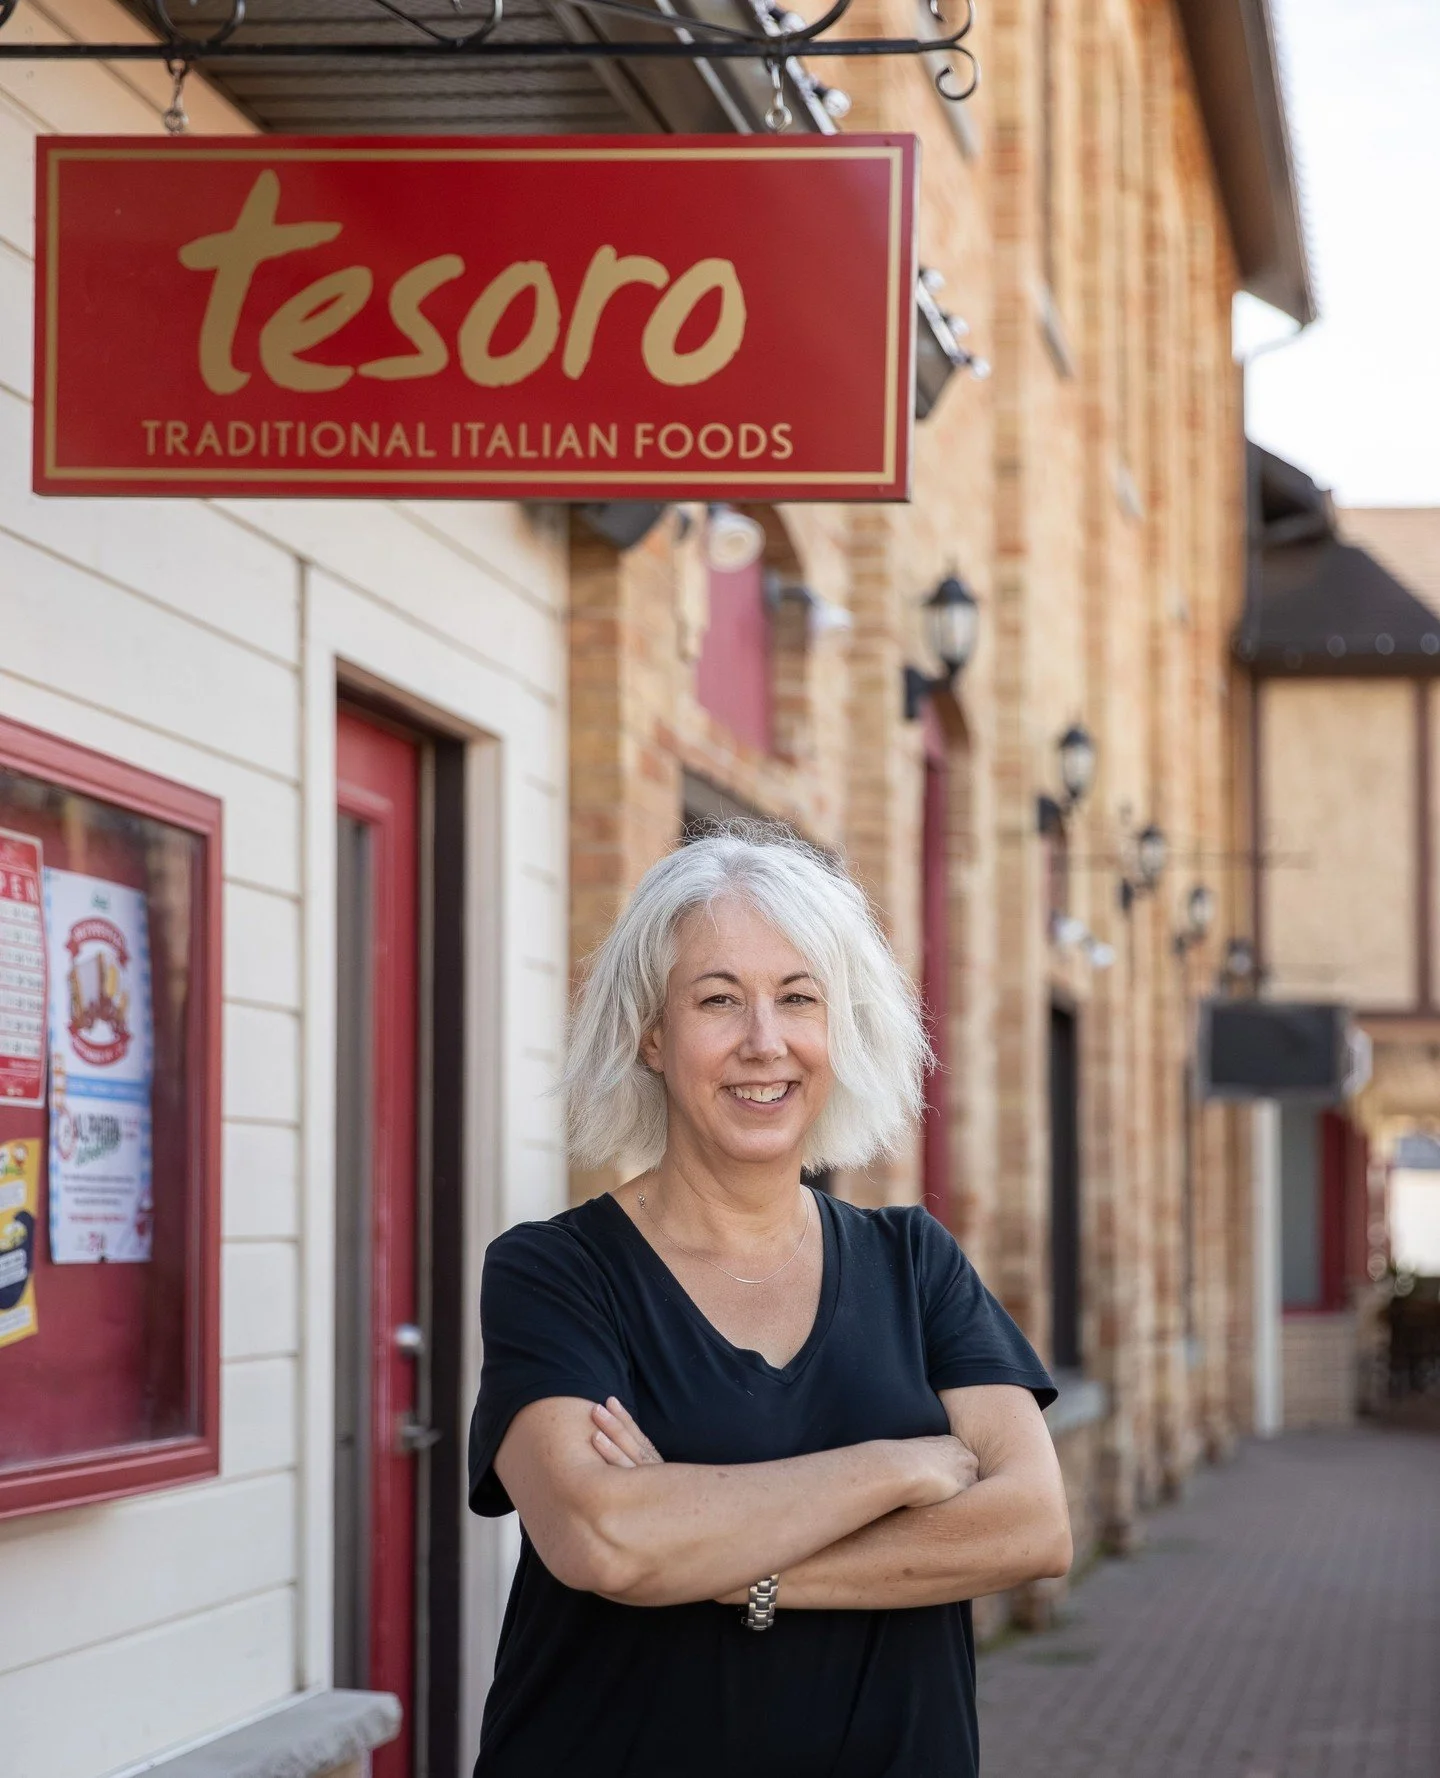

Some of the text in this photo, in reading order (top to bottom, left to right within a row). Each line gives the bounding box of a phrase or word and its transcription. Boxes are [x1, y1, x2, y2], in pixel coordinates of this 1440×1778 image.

[180, 170, 748, 394] tesoro
[143, 420, 795, 462] TRADITIONAL ITALIAN FOODS
